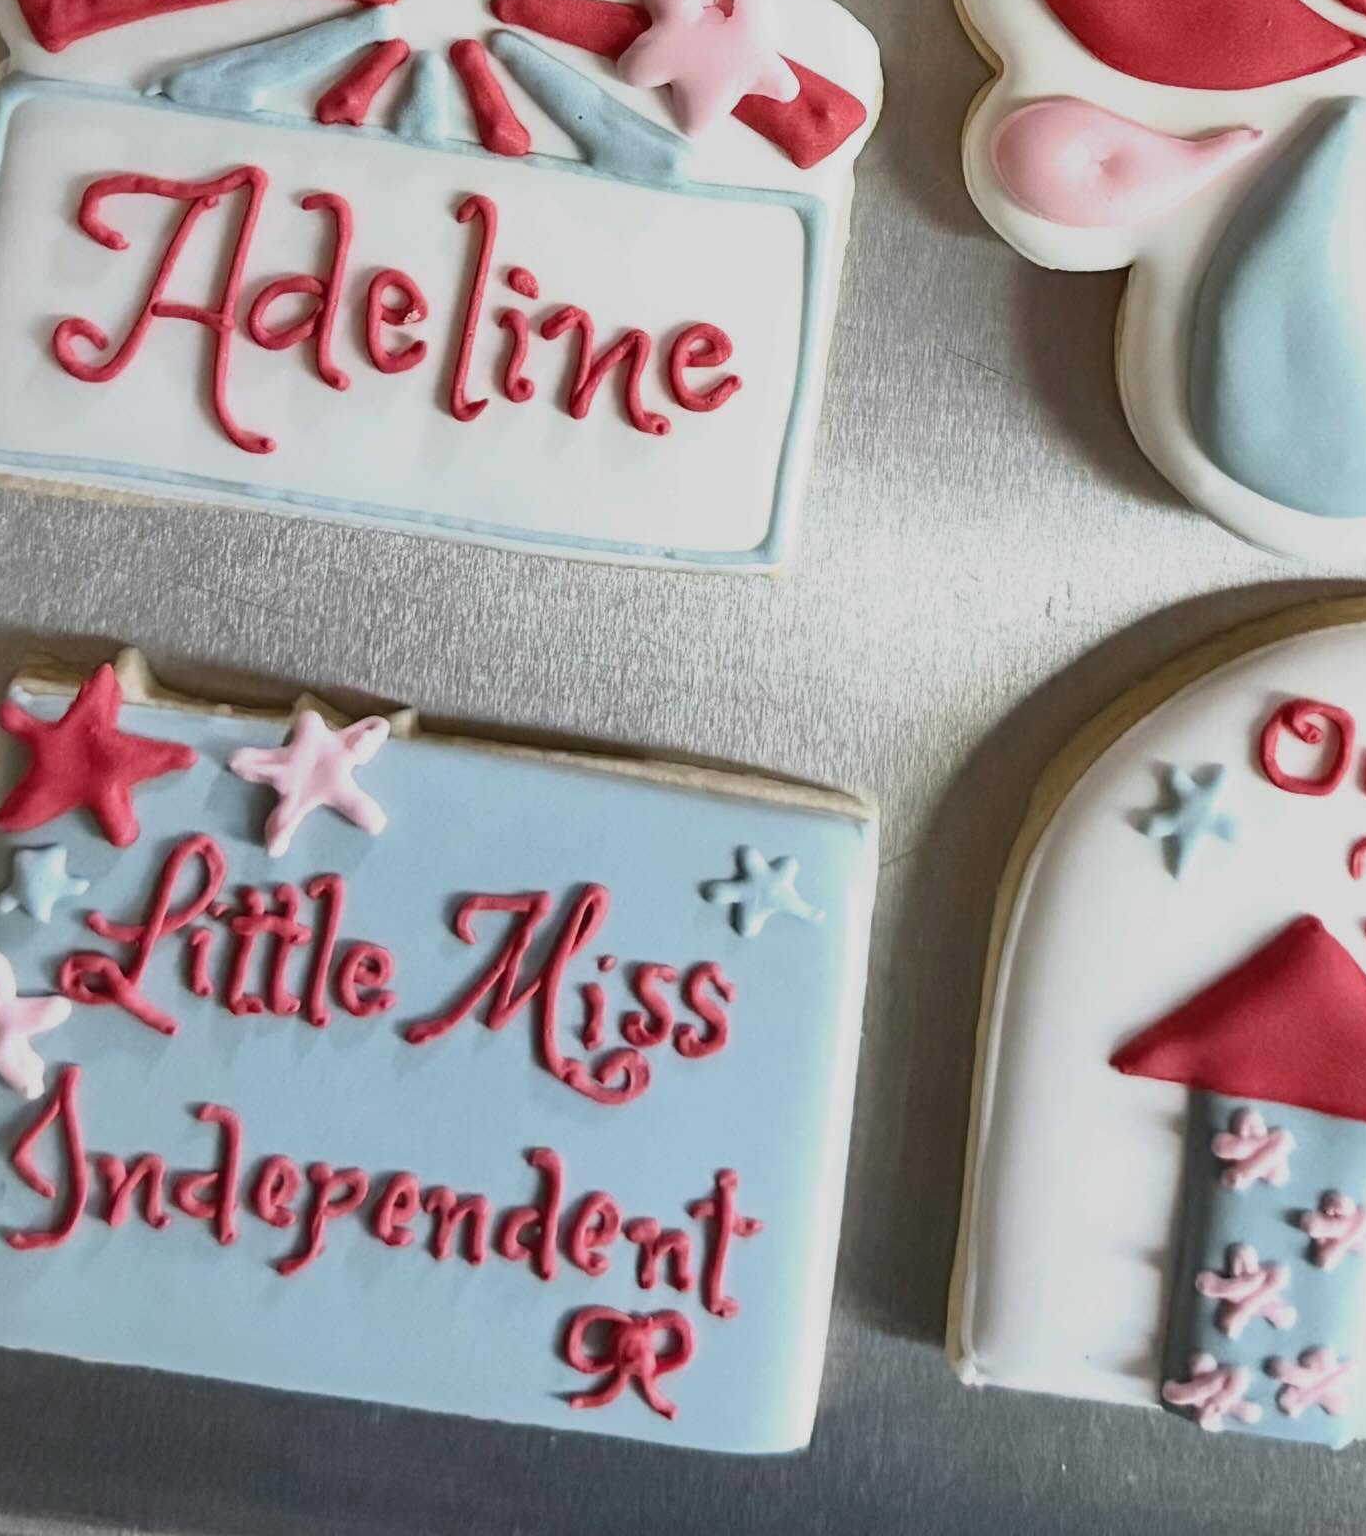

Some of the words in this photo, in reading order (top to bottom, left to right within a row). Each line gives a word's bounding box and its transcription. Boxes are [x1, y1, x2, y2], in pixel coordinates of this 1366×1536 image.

[52, 163, 743, 455] Adeline
[59, 831, 398, 1036] Little
[404, 882, 737, 1106] Miss
[5, 1063, 764, 1318] Independent
